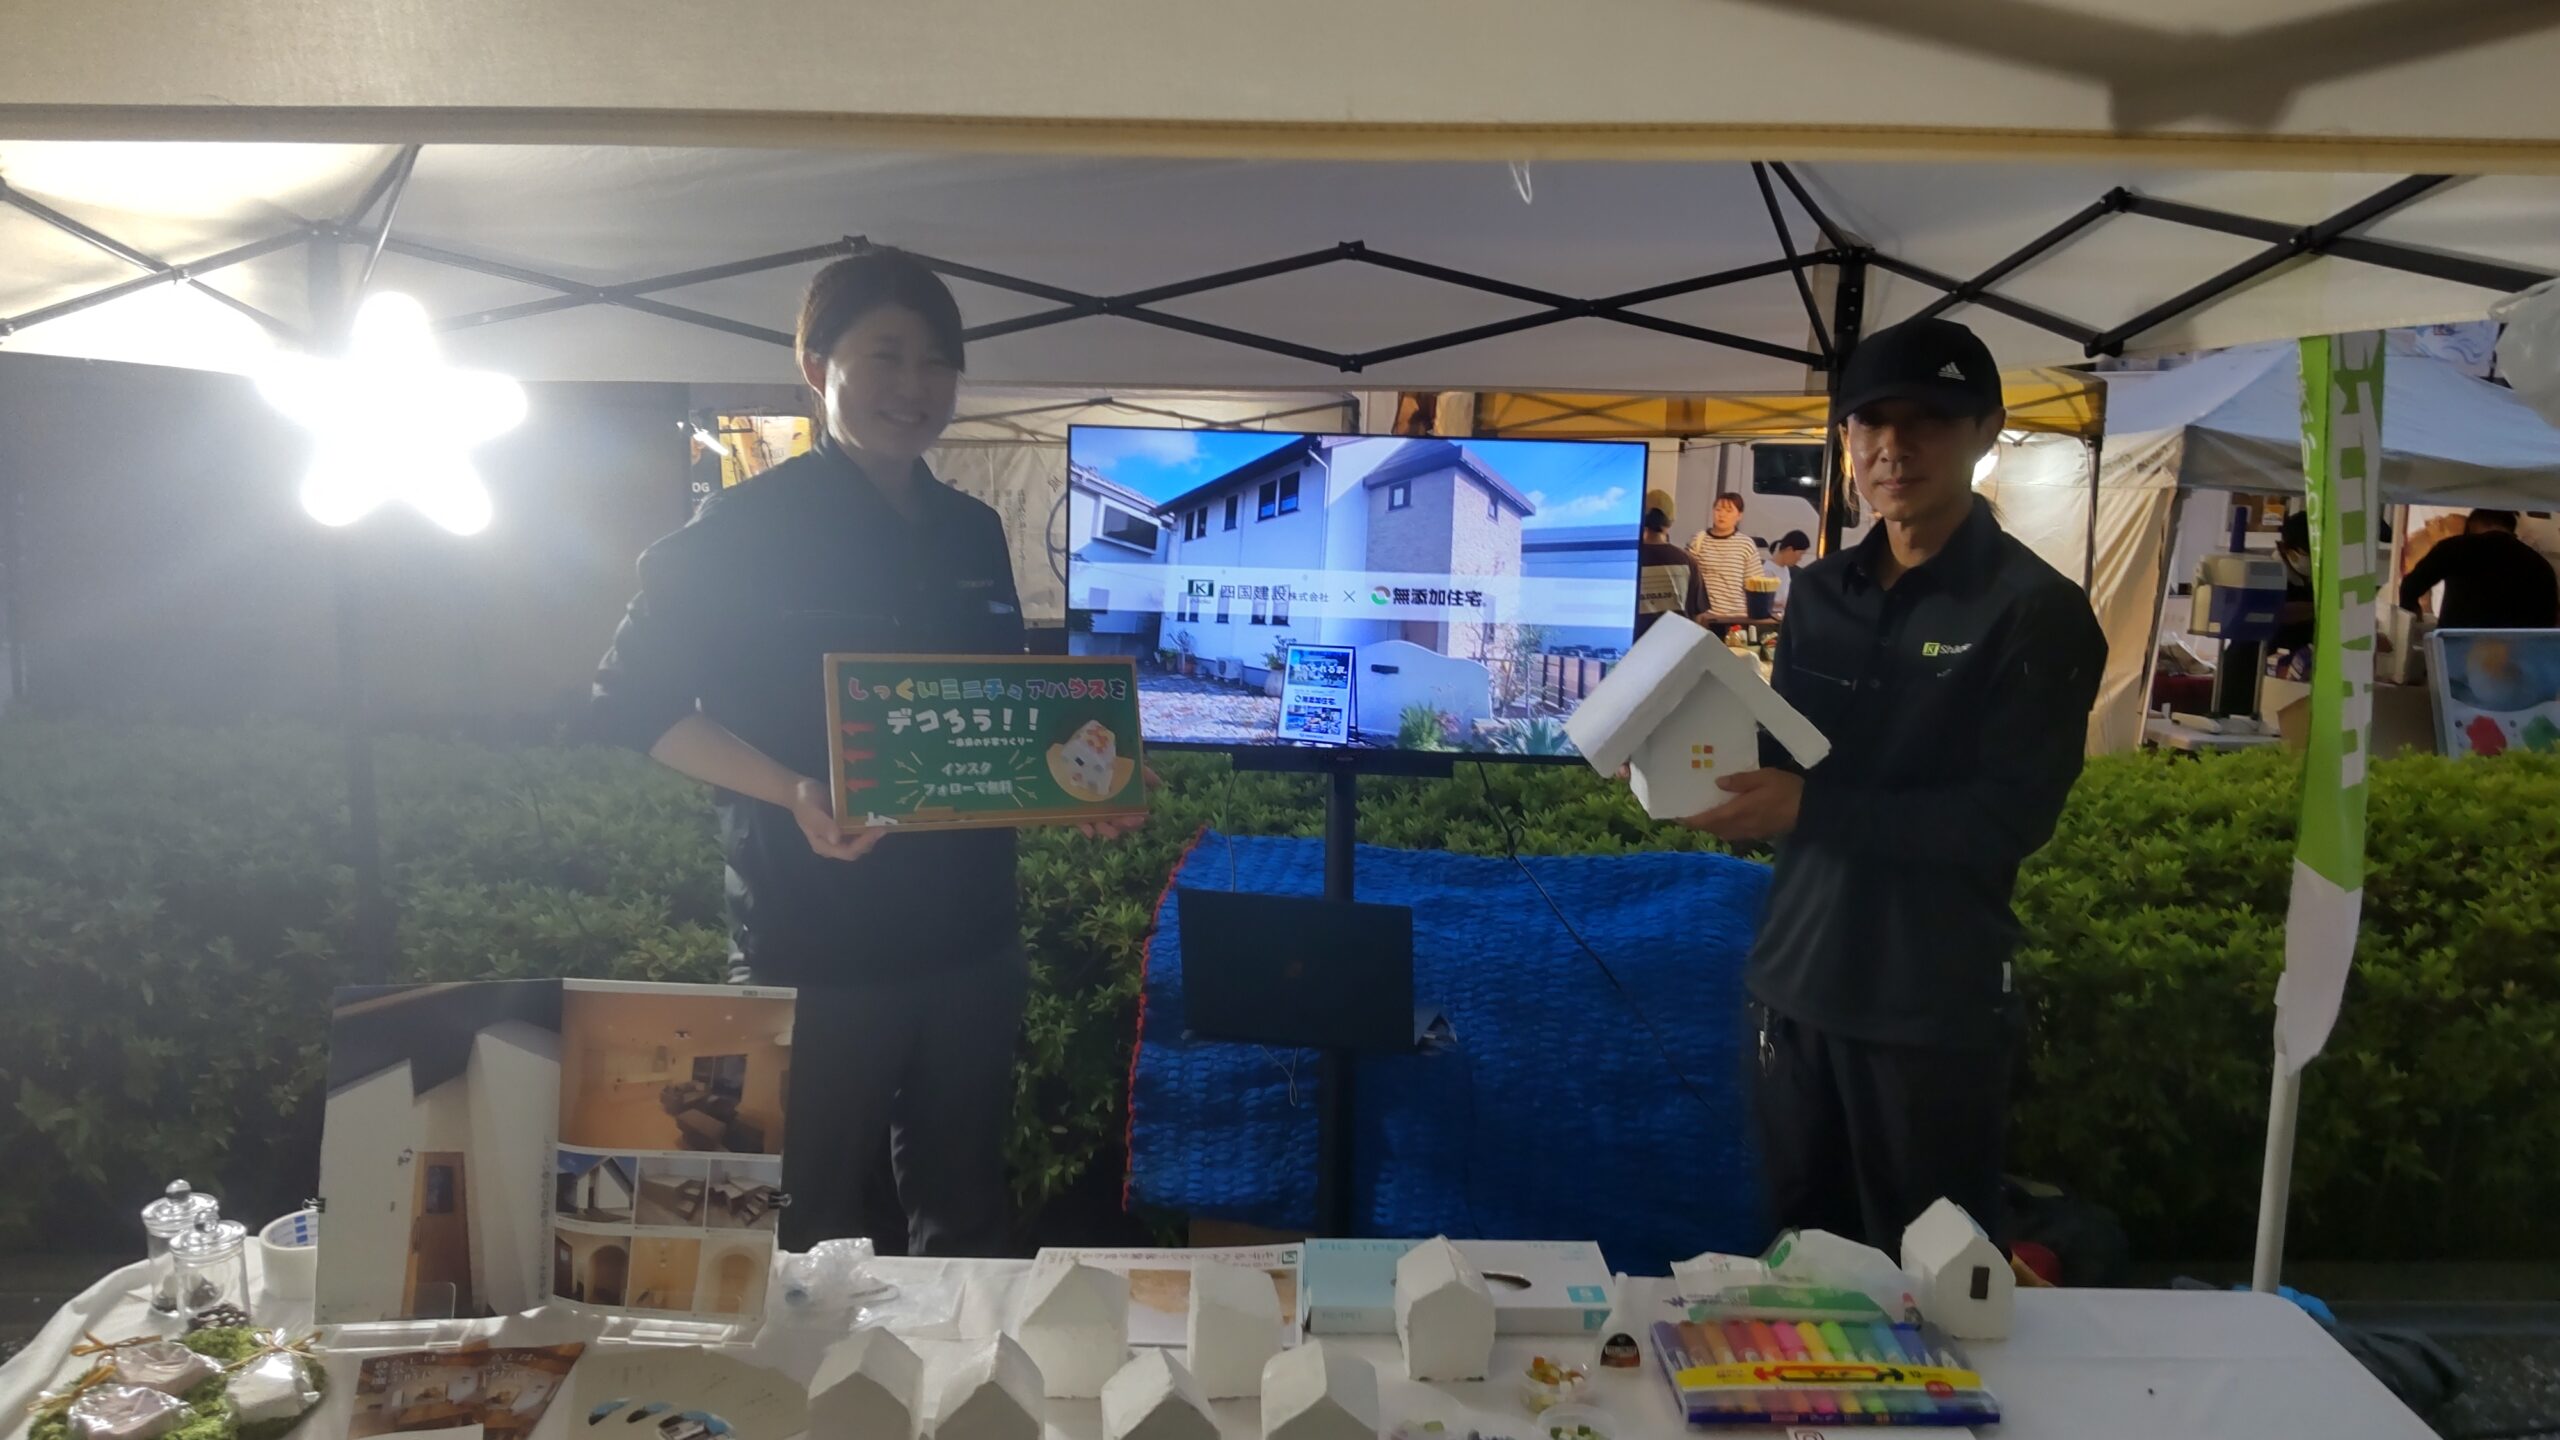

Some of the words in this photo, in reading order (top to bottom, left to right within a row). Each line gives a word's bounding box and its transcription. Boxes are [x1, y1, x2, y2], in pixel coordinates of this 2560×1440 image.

[1392, 587, 1483, 607] 無添加住宅
[848, 677, 1127, 701] しっくいミニチュアハウスを
[941, 762, 992, 776] インスタ
